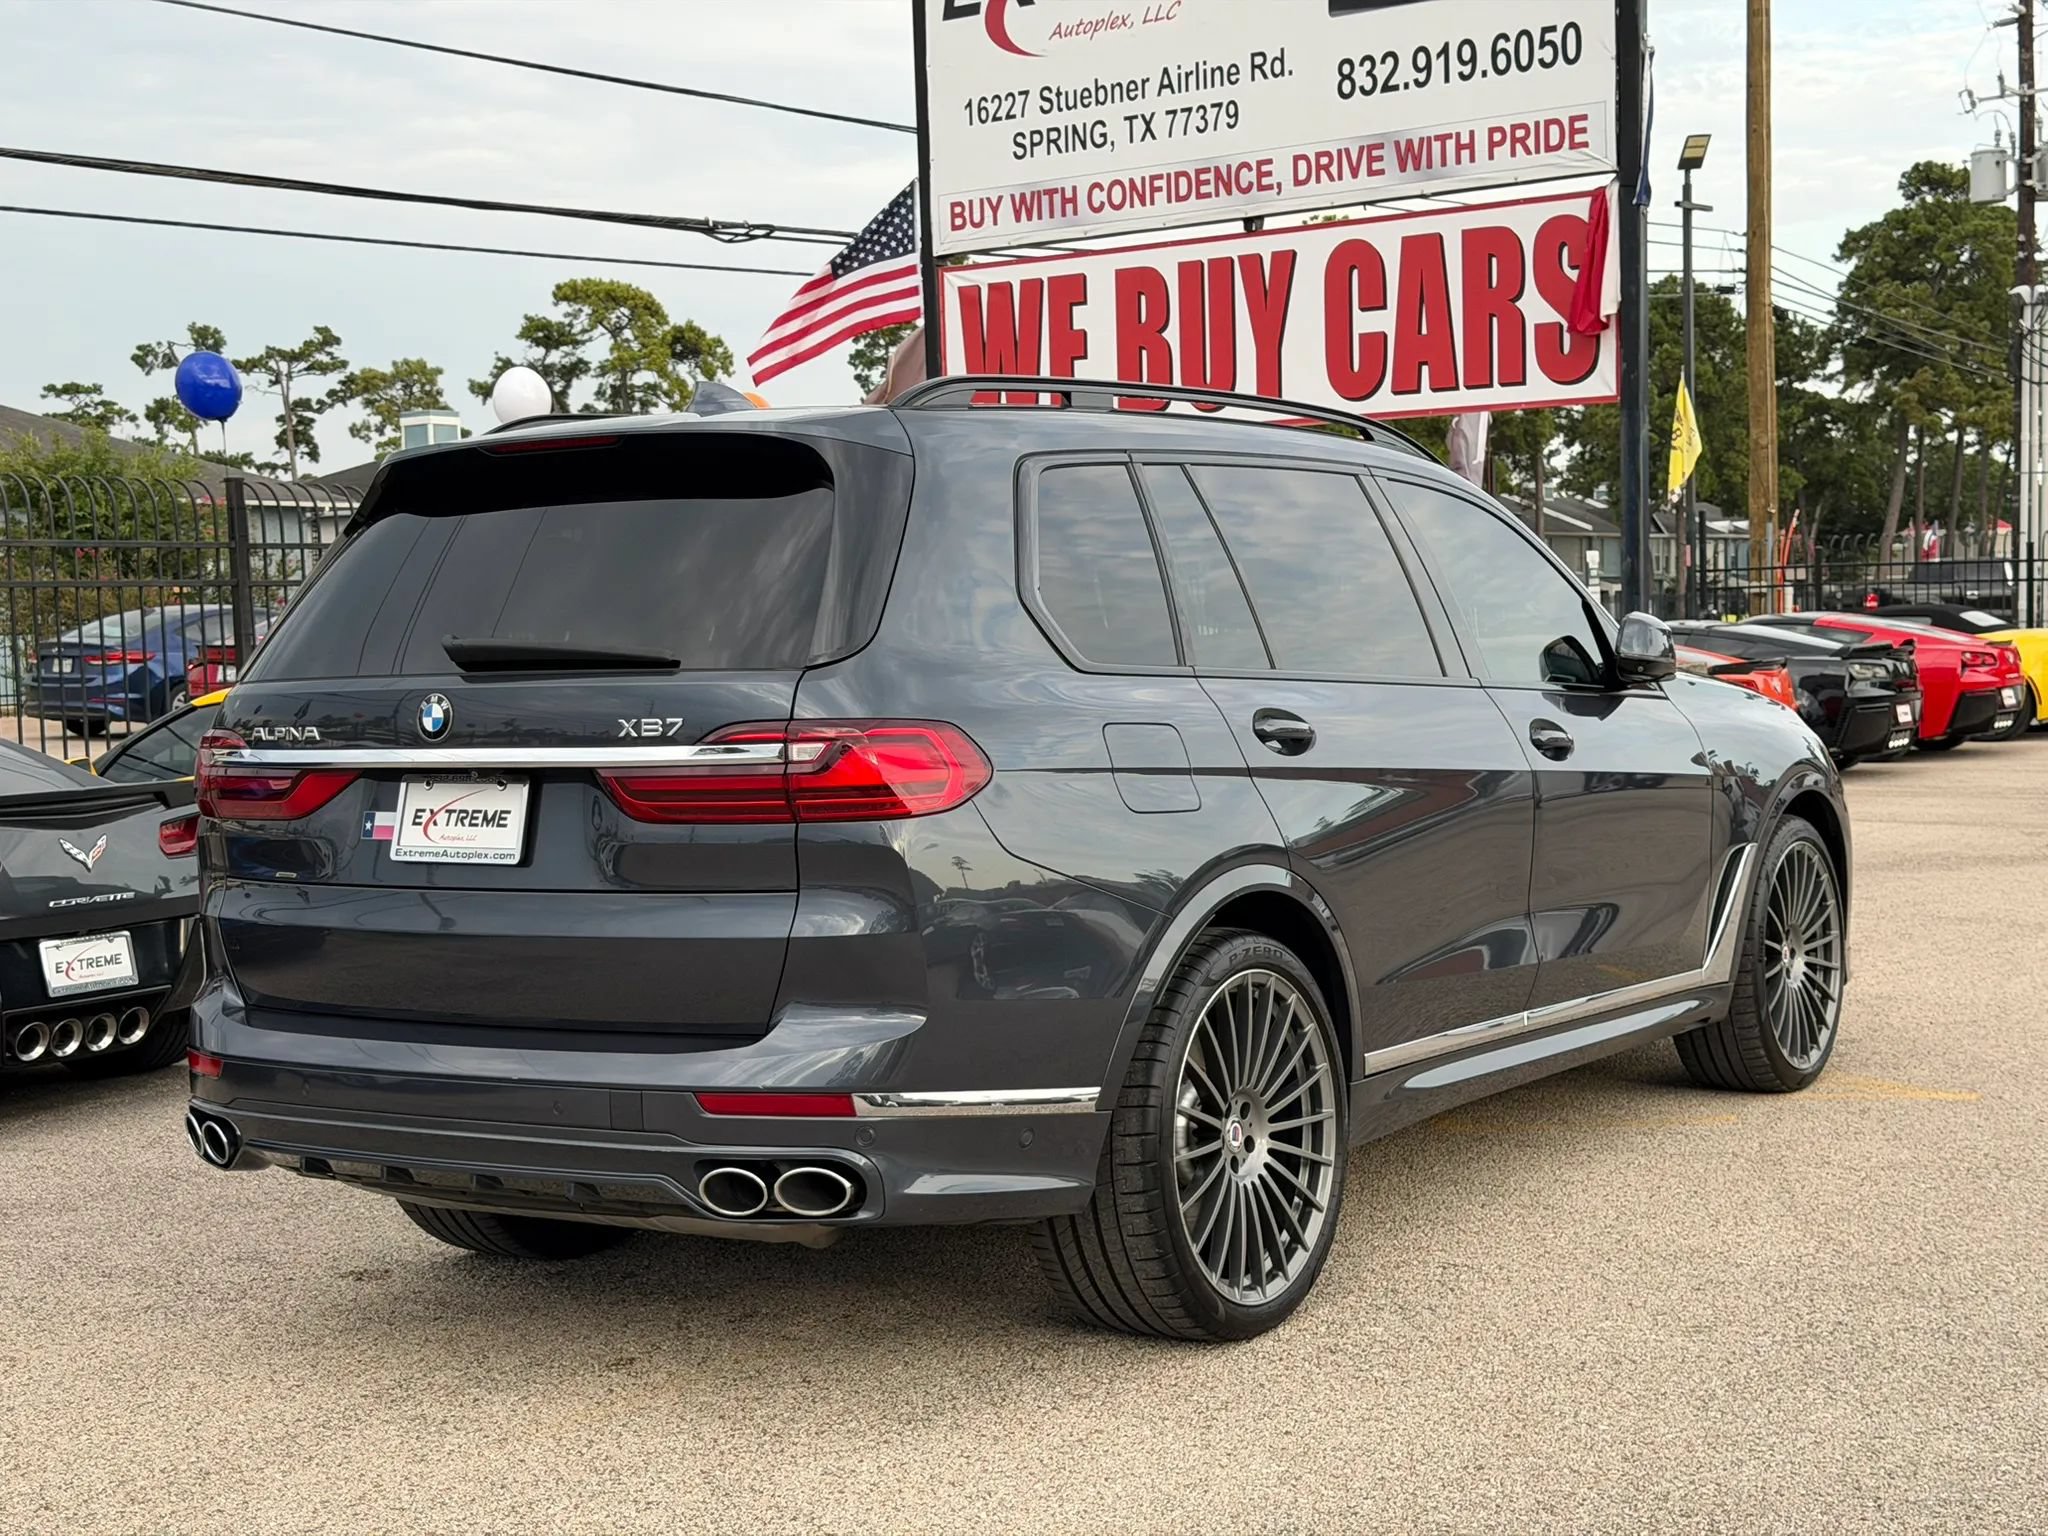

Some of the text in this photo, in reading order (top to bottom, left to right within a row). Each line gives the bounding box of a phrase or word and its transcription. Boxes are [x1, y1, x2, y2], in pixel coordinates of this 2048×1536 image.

[1048, 10, 1135, 41] Autoplex,
[1141, 0, 1182, 25] LLC
[1336, 21, 1583, 101] 832.919.6050
[964, 47, 1294, 126] 16227 Stuebner Airline Rd.
[1012, 100, 1240, 160] SPRING, TX 77379
[950, 114, 1590, 232] BUY WITH CONFIDENCE, DRIVE WITH PRIDE
[1114, 250, 1297, 412] BUY
[1323, 213, 1600, 402] CARS
[420, 695, 449, 710] BMW
[617, 717, 684, 737] XB7
[411, 808, 512, 828] EXTREME
[395, 847, 516, 860] ExtremeAutoplex.com
[49, 891, 136, 908] CORVETTE
[55, 953, 123, 974] EXTREME
